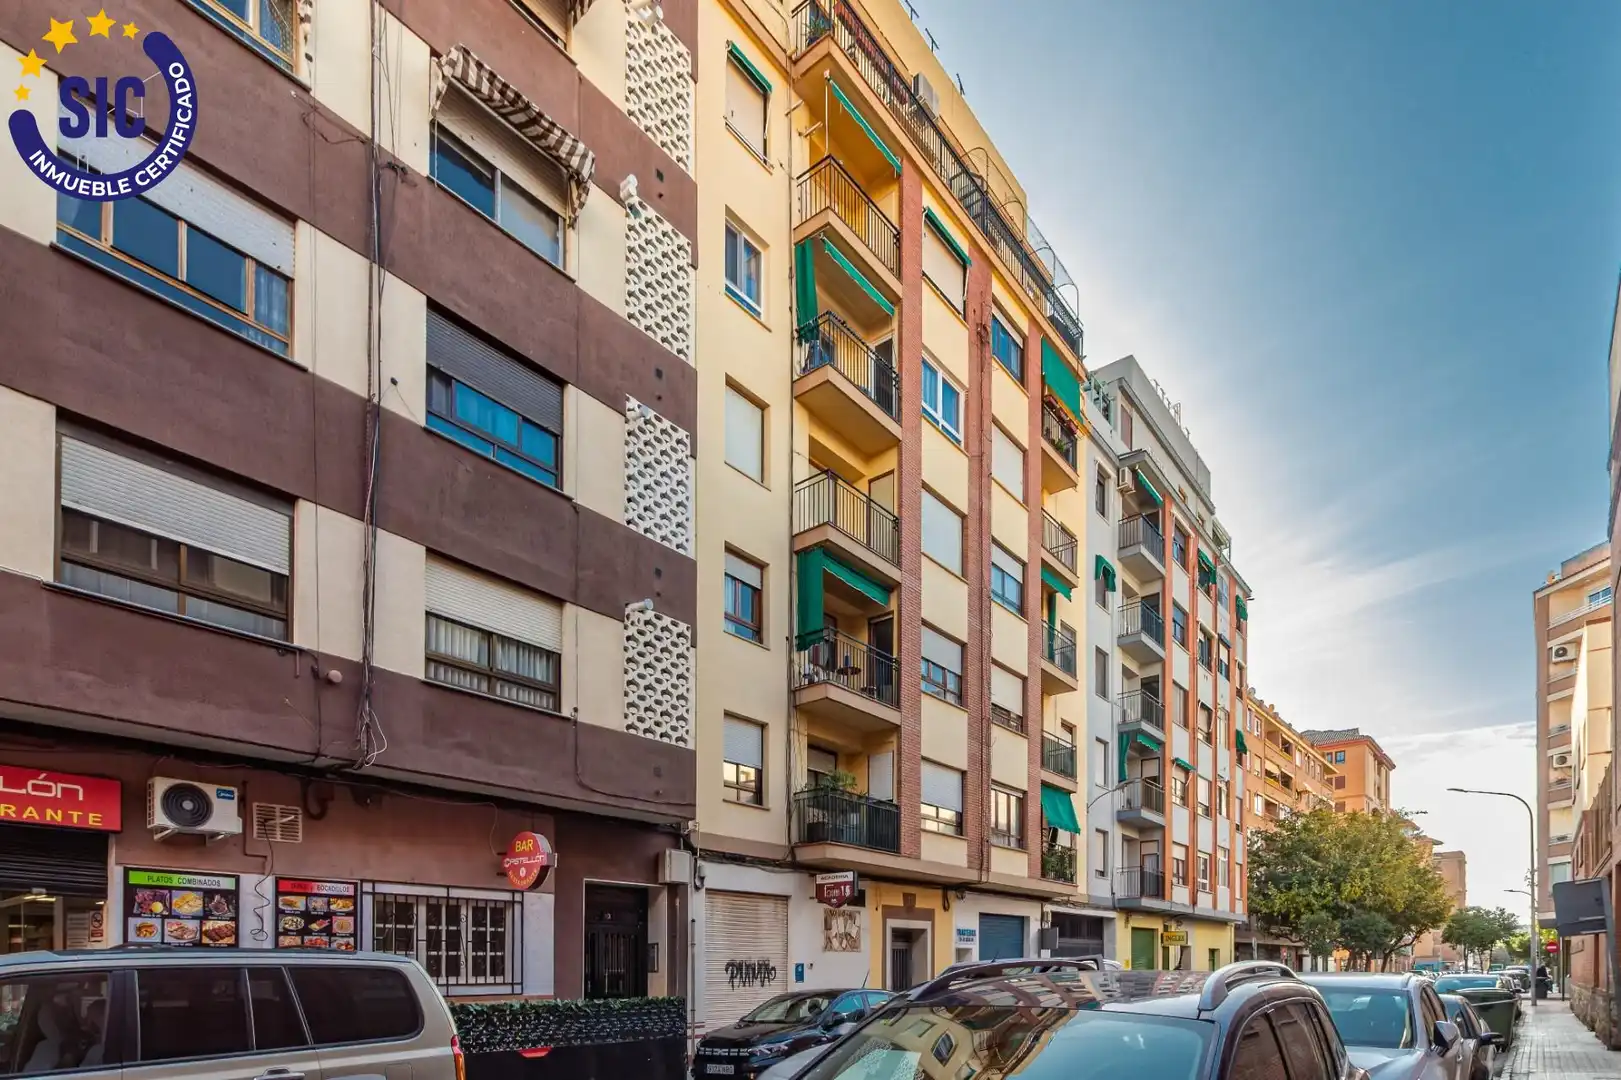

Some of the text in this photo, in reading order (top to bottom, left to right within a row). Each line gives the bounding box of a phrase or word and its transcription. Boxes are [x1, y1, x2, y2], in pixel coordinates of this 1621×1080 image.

[0, 803, 103, 826] RANTE
[515, 839, 534, 852] BAR
[147, 875, 221, 887] PLATOS COMBINADOS
